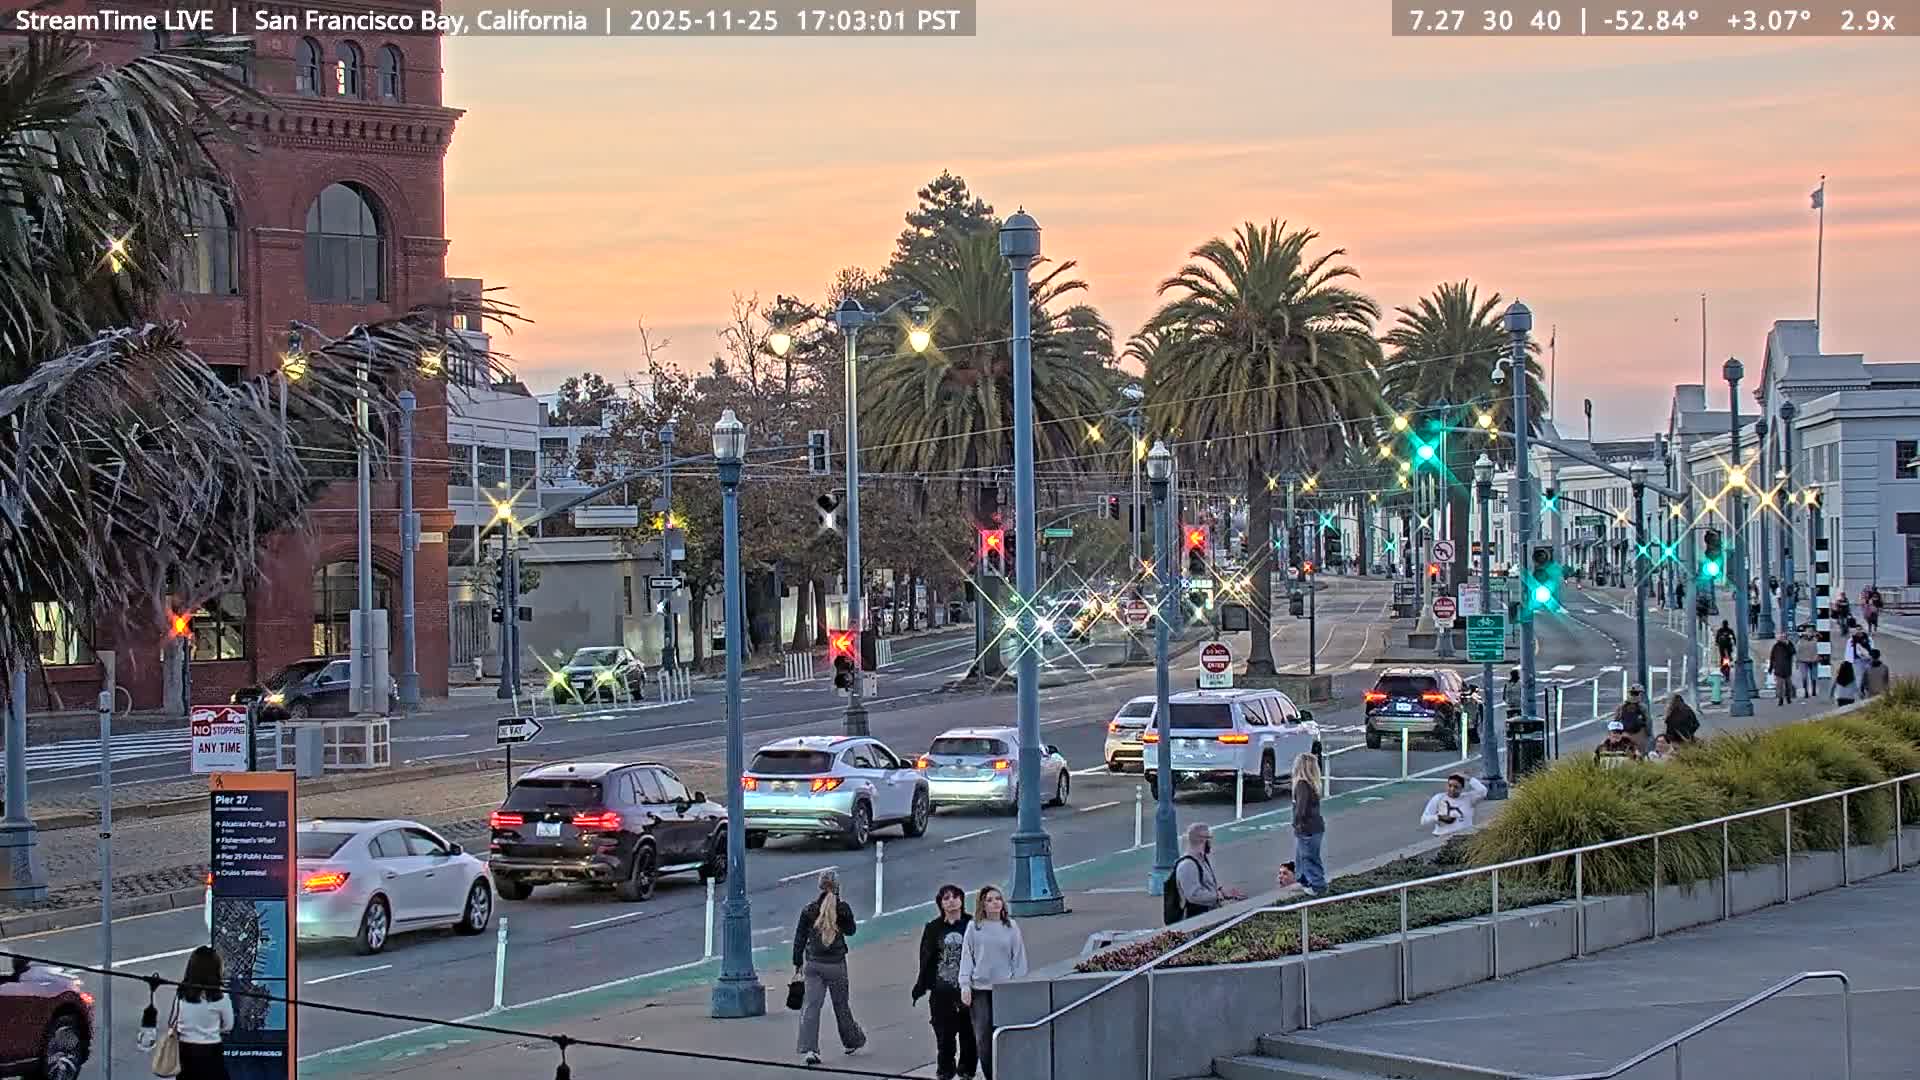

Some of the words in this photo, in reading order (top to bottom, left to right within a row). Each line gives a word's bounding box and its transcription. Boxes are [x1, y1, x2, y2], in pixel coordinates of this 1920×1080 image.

[193, 725, 210, 736] NO
[212, 726, 246, 735] STOPPING
[198, 742, 217, 754] ANY
[219, 742, 241, 753] TIME
[215, 795, 234, 805] Pier
[236, 795, 248, 805] 27
[221, 869, 240, 877] Cruise
